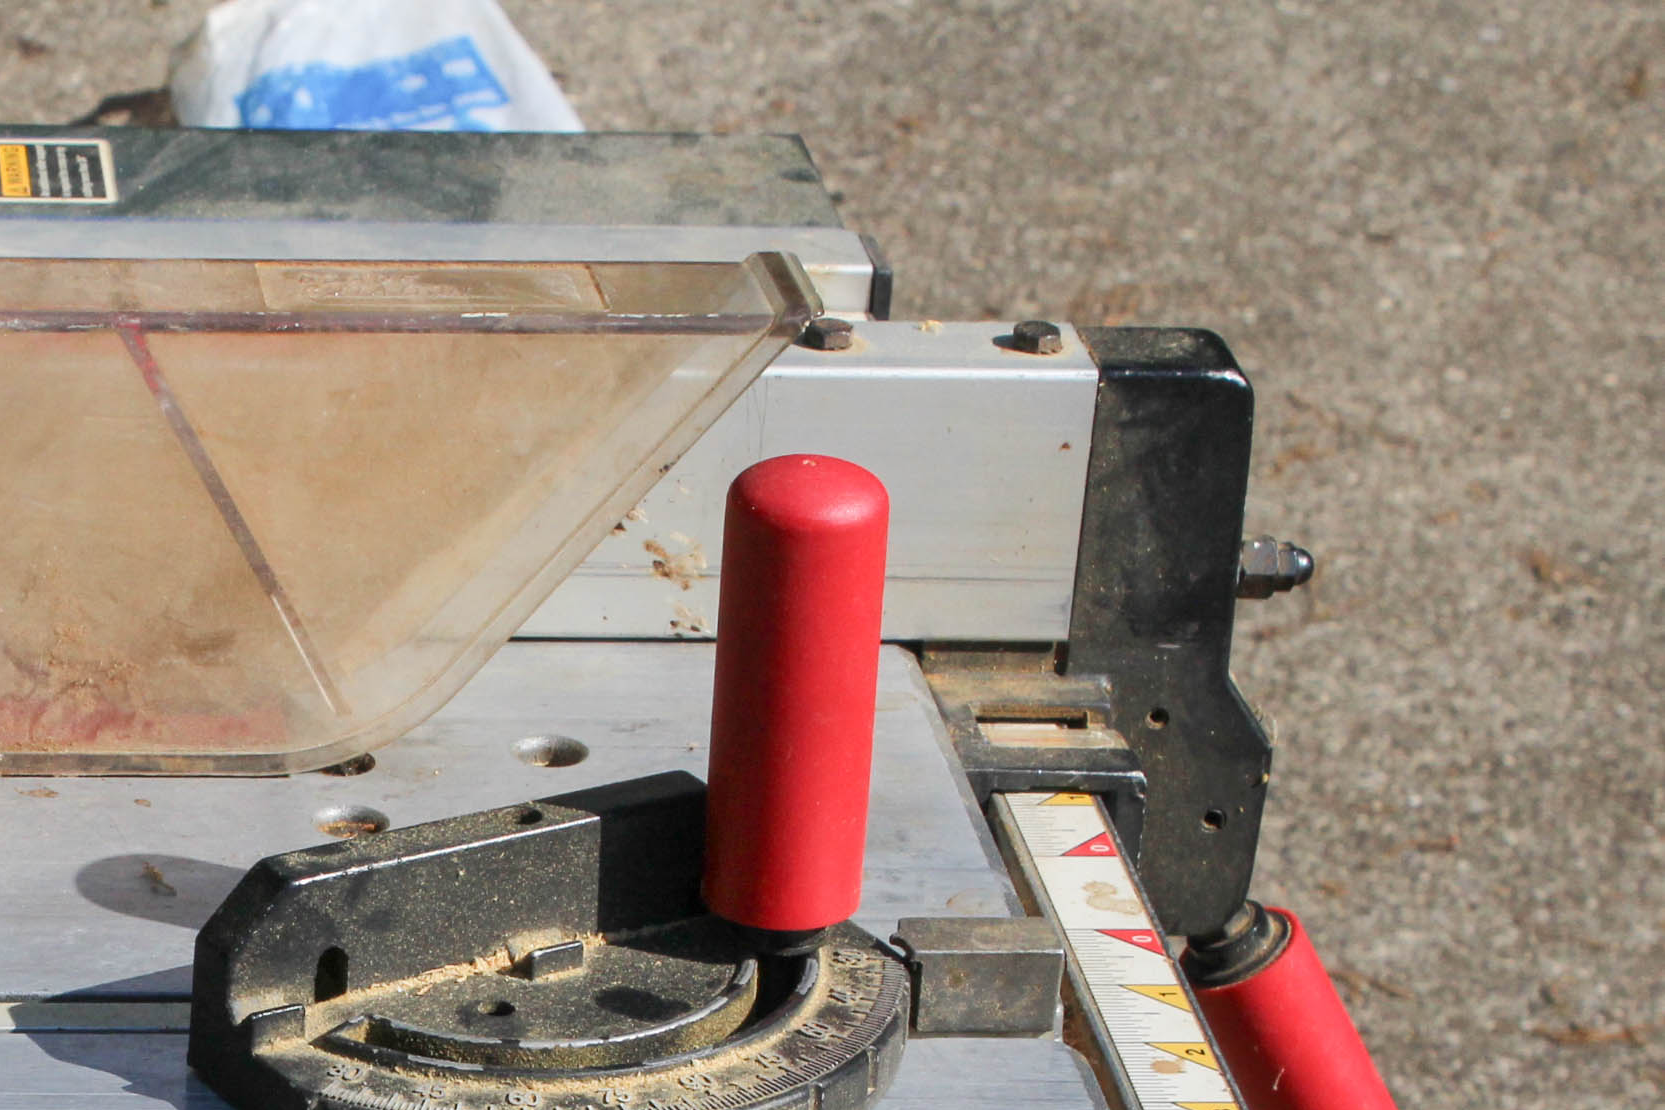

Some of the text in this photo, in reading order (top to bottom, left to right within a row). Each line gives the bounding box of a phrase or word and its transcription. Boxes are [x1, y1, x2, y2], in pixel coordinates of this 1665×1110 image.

[1089, 844, 1110, 852] 0
[1131, 936, 1152, 944] 0
[799, 1022, 831, 1040] 60
[1185, 1047, 1206, 1056] 2
[754, 1053, 785, 1068] 75
[678, 1072, 714, 1091] 90
[412, 1085, 447, 1100] 45
[505, 1091, 542, 1107] 60
[594, 1087, 632, 1104] 75
